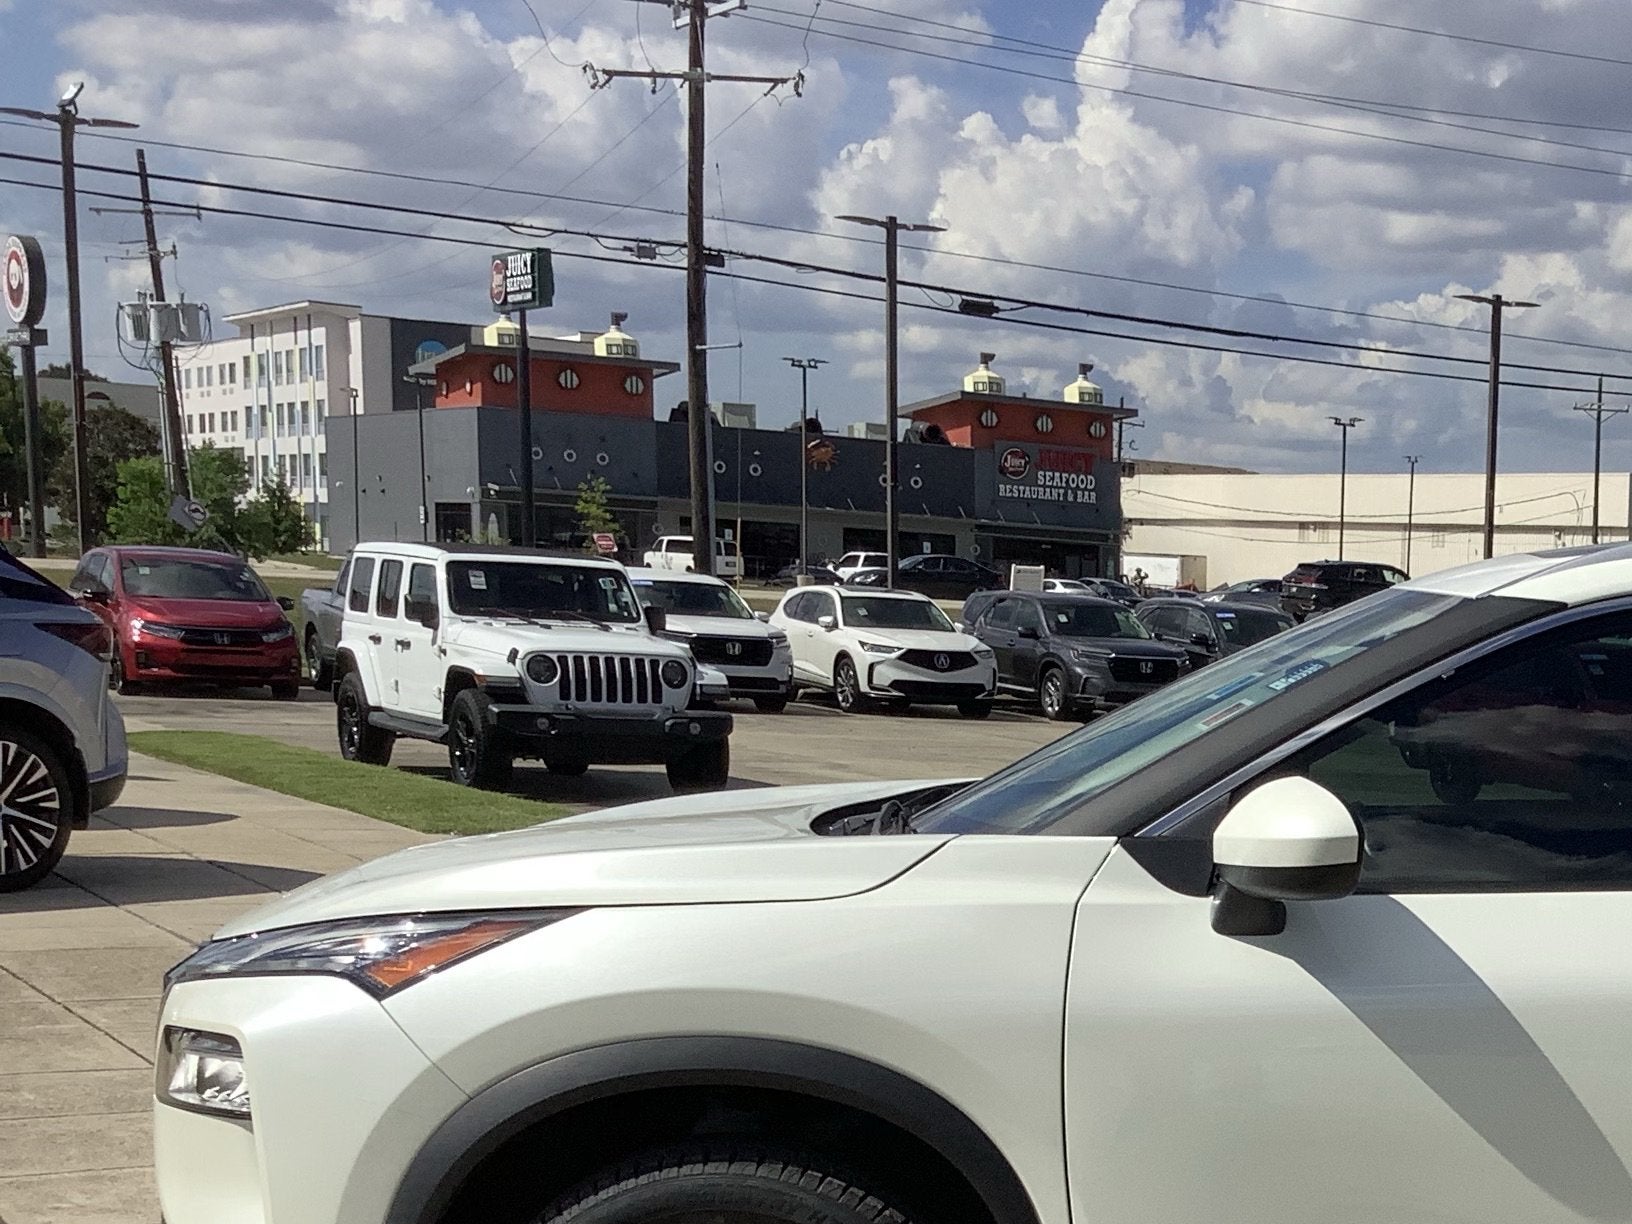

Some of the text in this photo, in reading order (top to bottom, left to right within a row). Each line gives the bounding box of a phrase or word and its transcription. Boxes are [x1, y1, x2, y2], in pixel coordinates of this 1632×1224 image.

[506, 252, 532, 277] JUICY
[1037, 471, 1095, 489] SEAFOOD
[999, 484, 1096, 504] RESTAURANT & BAR
